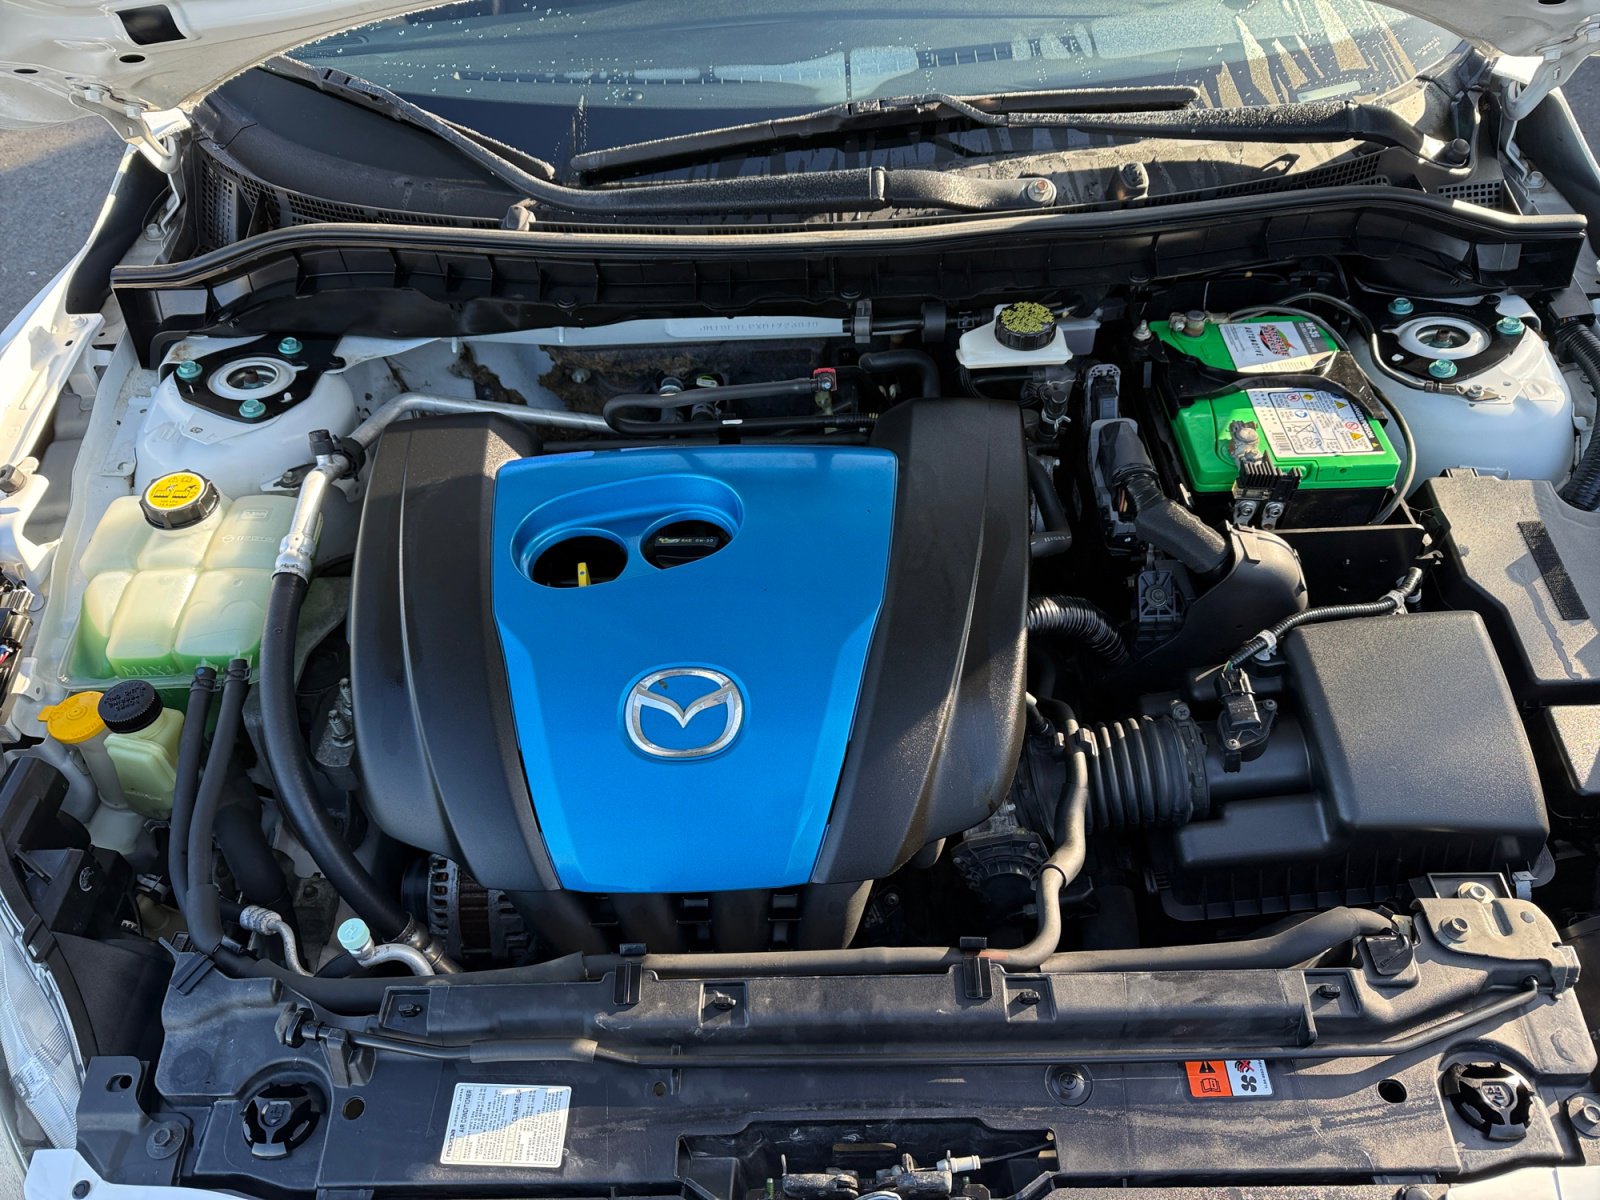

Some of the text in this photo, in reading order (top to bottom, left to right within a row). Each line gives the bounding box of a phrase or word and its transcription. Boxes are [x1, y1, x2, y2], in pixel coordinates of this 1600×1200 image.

[1245, 326, 1264, 356] AUTOMOTIVE
[461, 1089, 472, 1123] CONDITIONER
[446, 1129, 456, 1157] mazda
